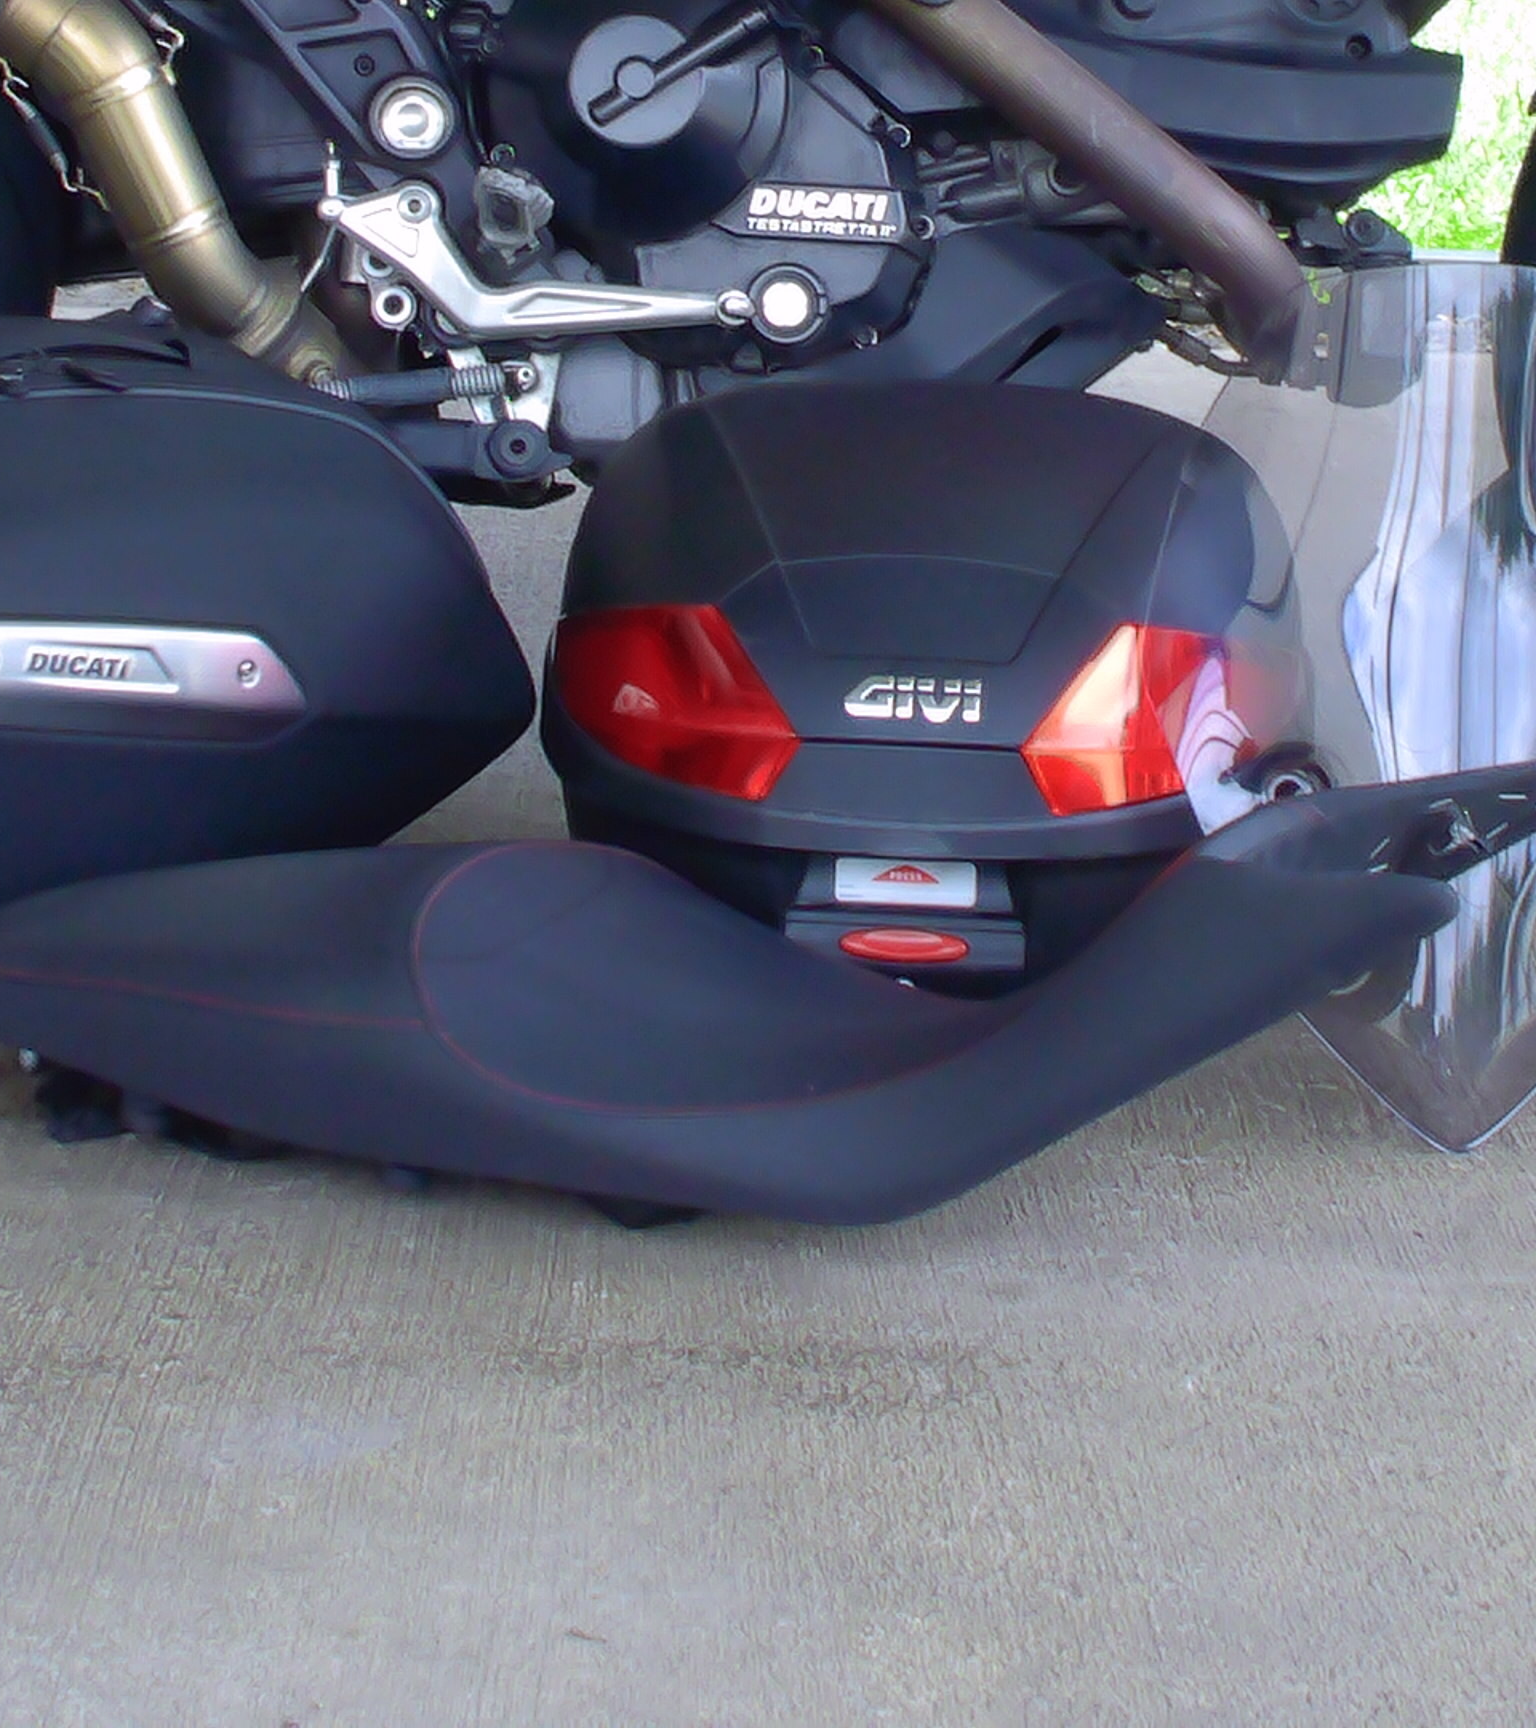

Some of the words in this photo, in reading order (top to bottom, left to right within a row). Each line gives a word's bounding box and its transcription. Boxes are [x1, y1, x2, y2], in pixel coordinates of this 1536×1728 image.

[748, 187, 889, 222] DUCATI
[26, 652, 133, 680] DUCATI
[843, 674, 982, 723] GIVI
